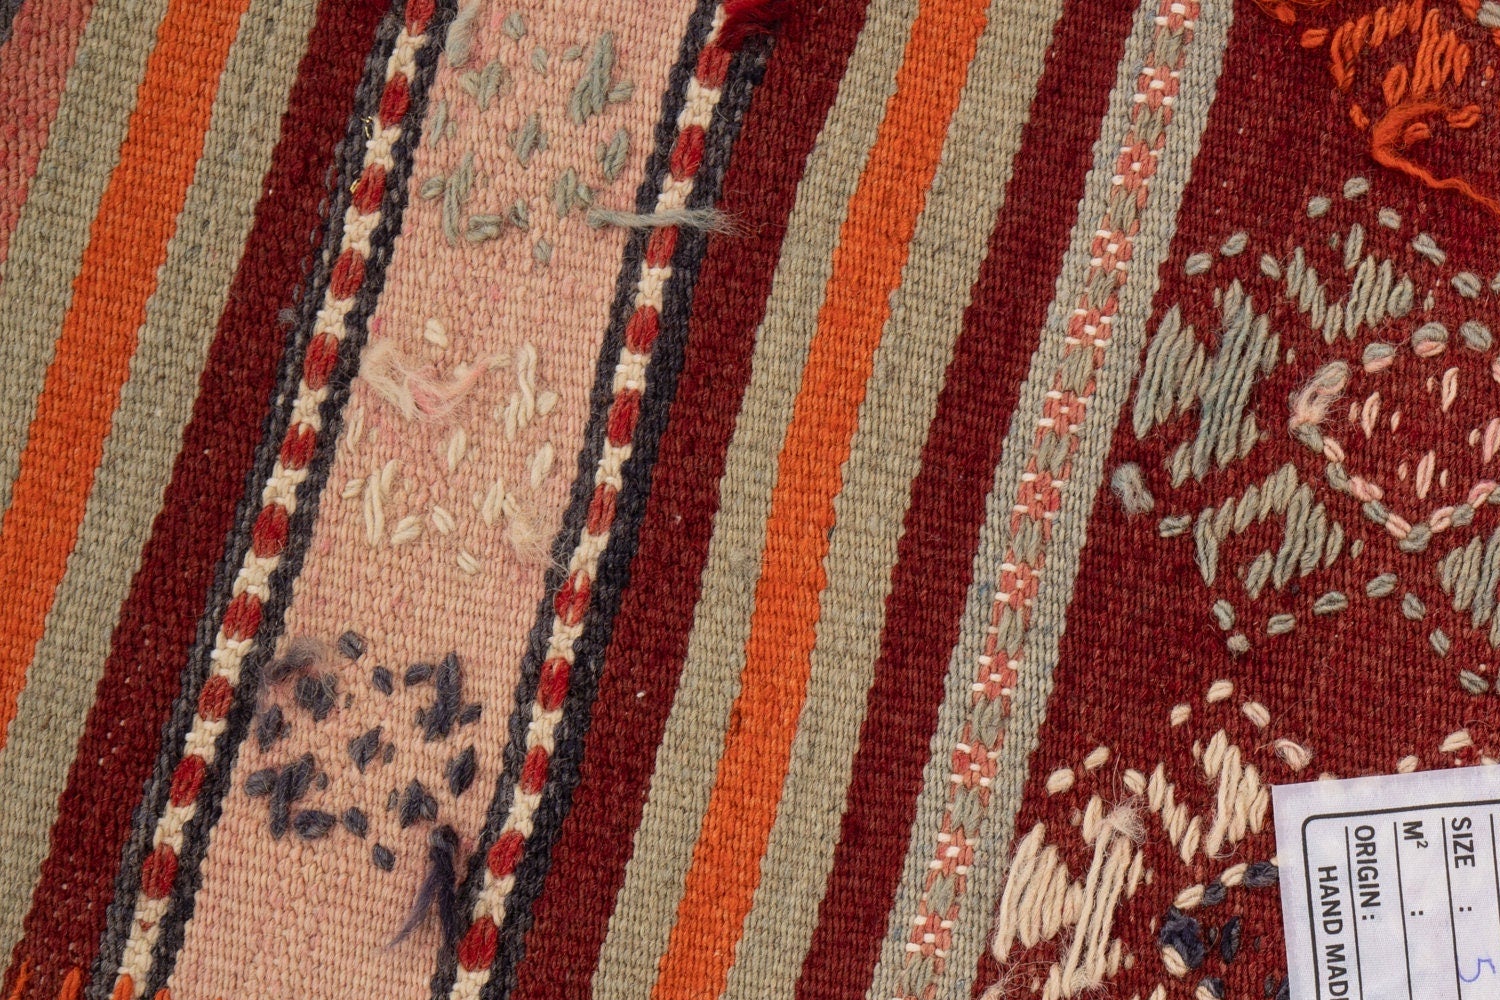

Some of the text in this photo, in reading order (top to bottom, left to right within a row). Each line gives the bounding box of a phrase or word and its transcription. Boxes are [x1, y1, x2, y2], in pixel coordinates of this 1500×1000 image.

[1354, 824, 1381, 920] ORIGIN:
[1451, 817, 1475, 869] SIZE
[1317, 865, 1343, 935] HAND
[1458, 957, 1496, 983] 5
